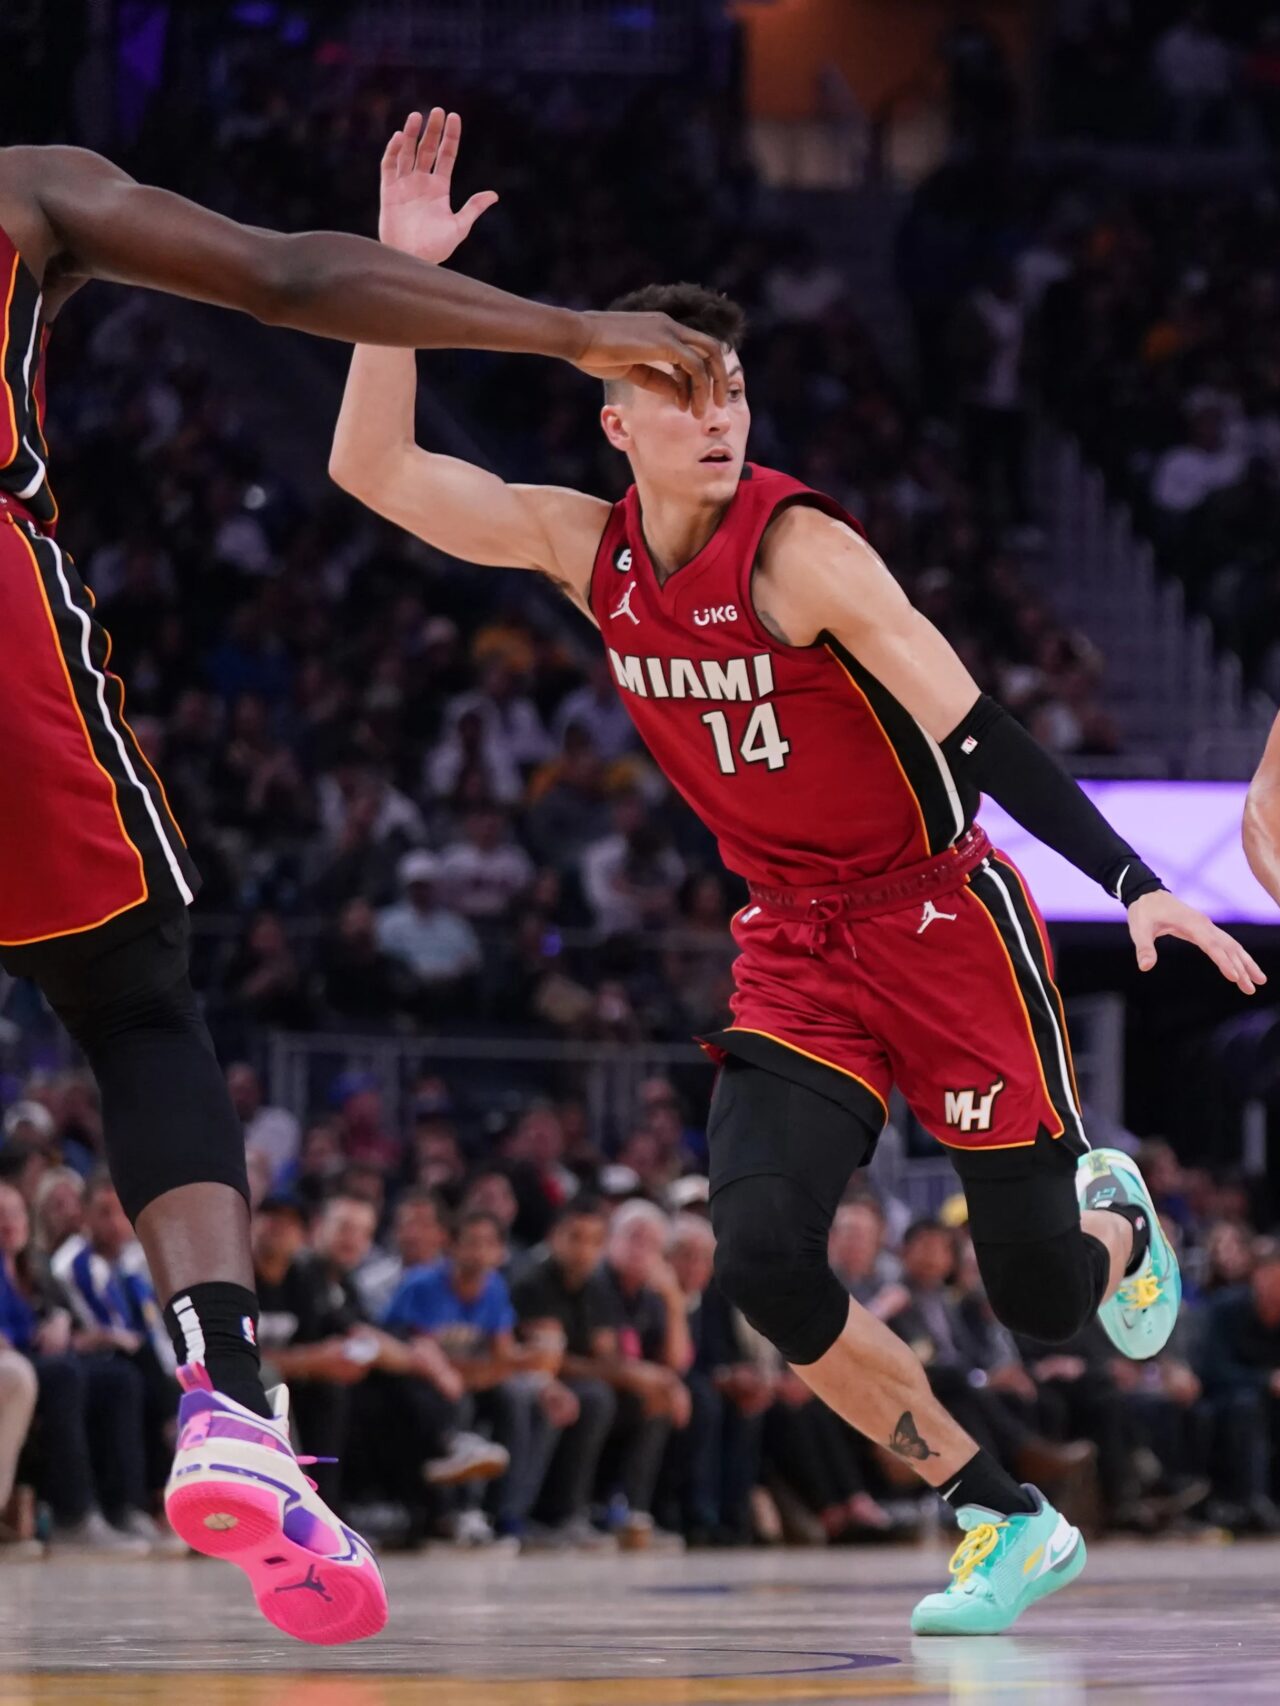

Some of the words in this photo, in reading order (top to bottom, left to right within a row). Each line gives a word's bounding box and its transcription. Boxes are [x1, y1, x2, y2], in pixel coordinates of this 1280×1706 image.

[616, 548, 633, 571] 6
[608, 647, 774, 702] MIAMI
[702, 702, 789, 774] 14
